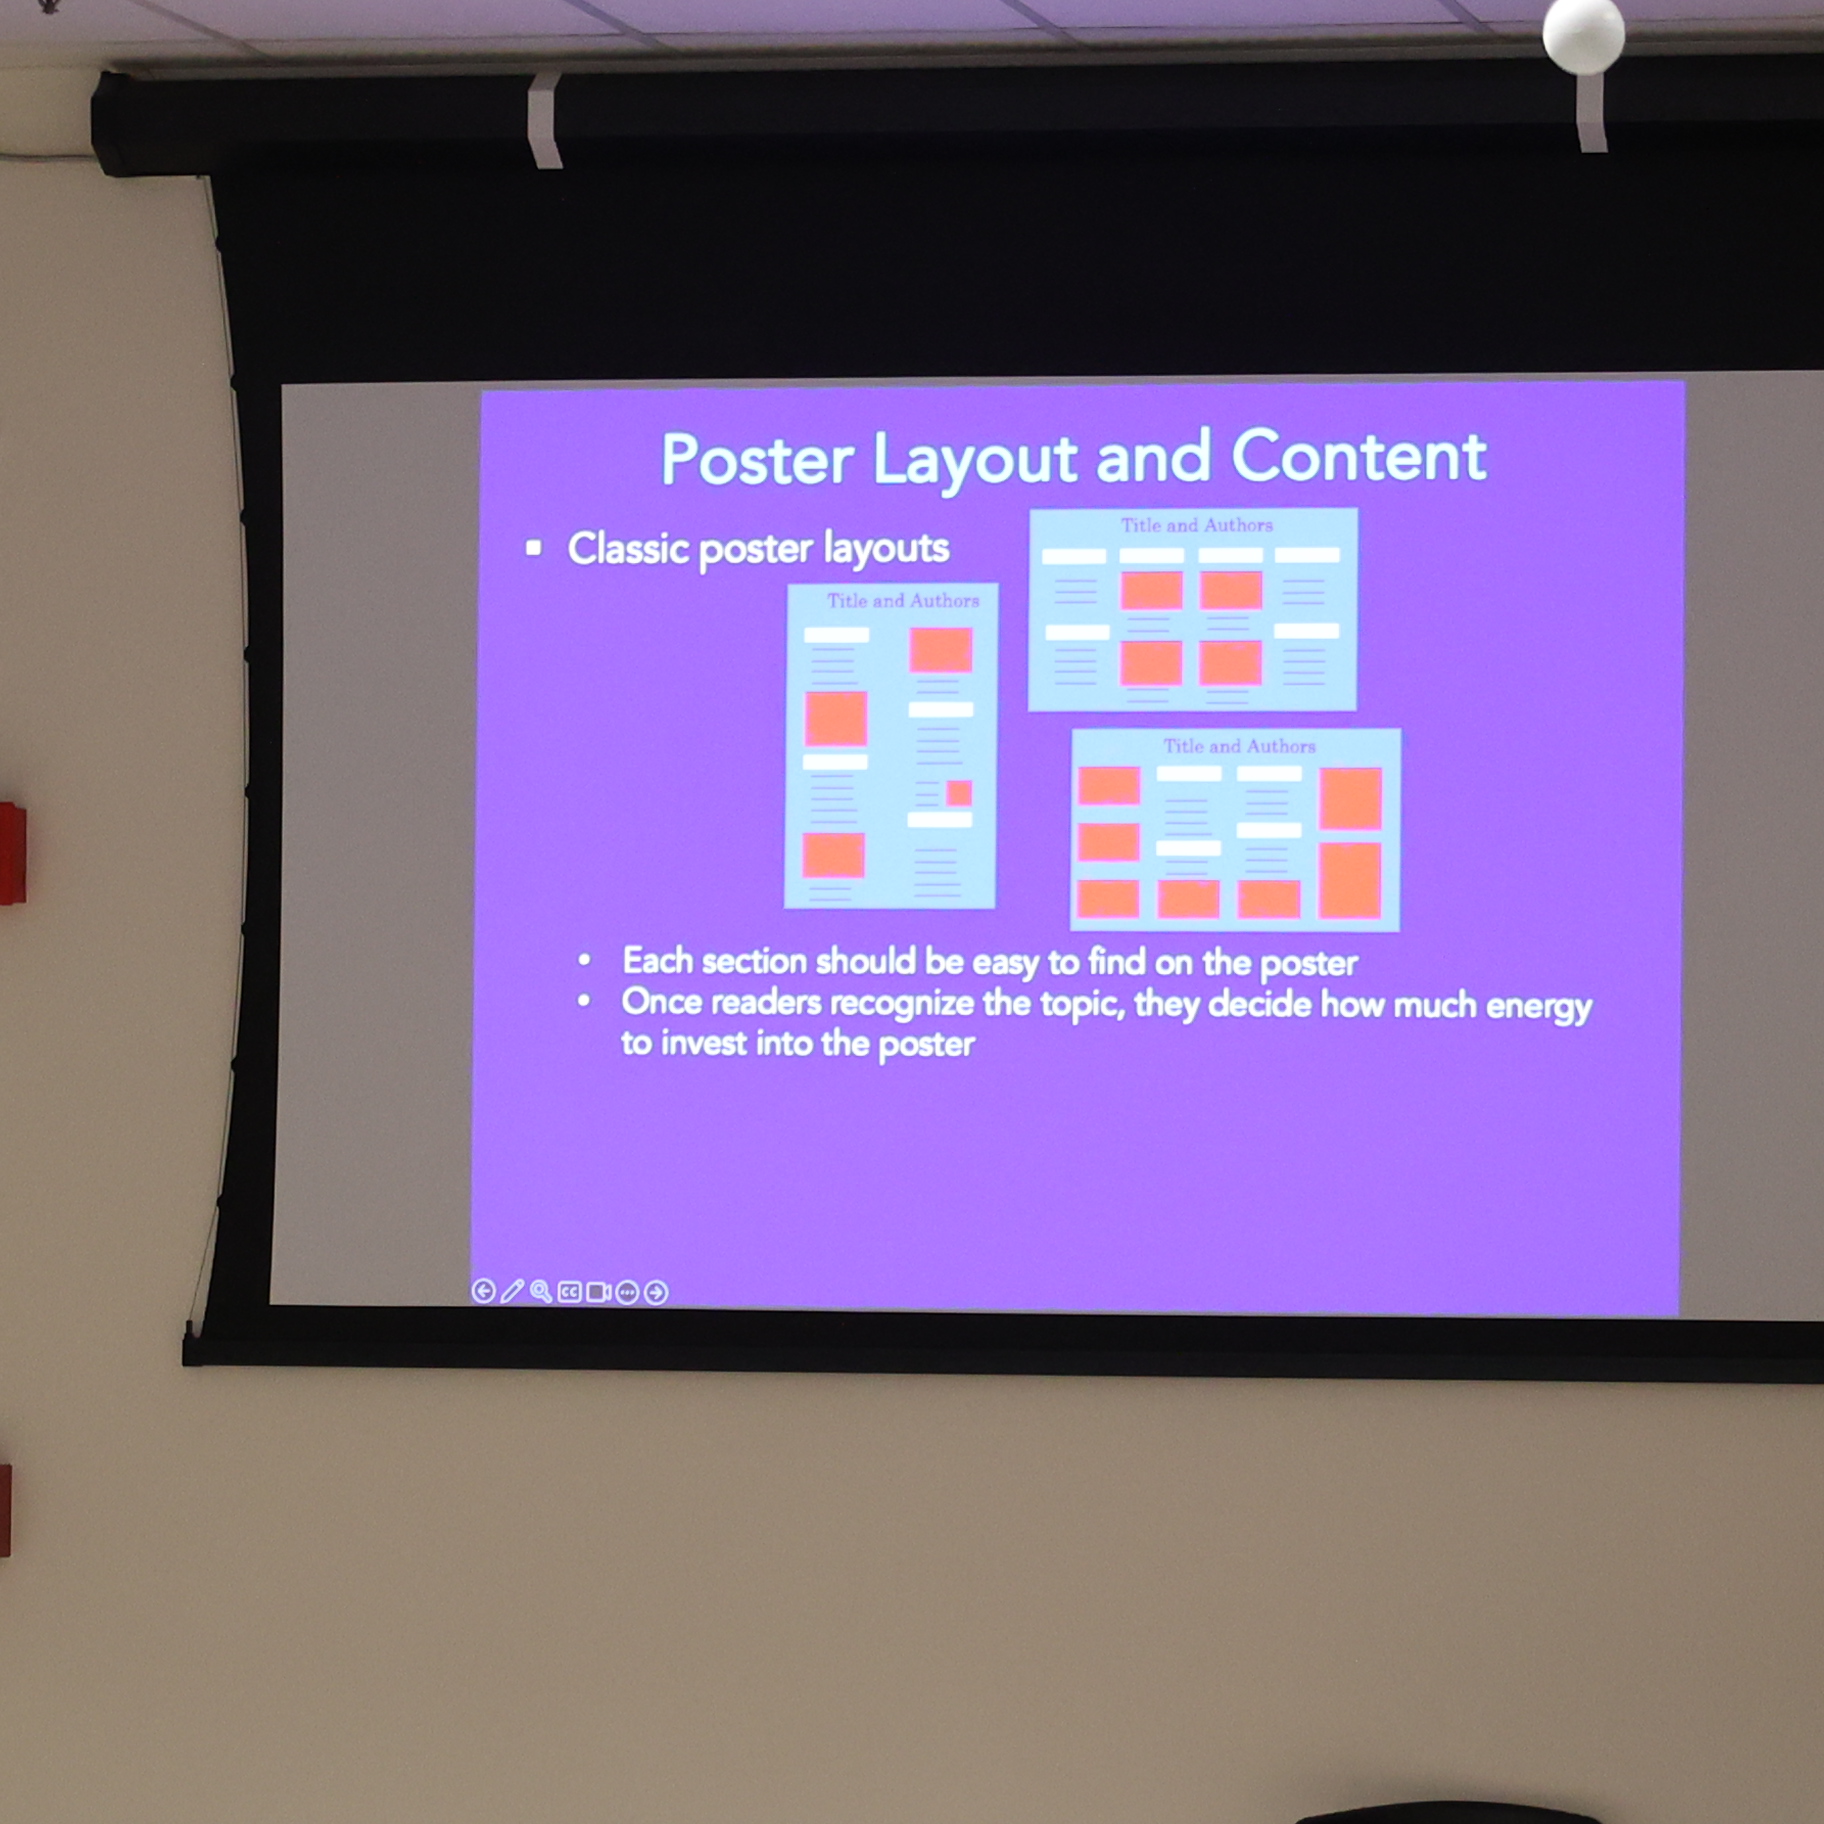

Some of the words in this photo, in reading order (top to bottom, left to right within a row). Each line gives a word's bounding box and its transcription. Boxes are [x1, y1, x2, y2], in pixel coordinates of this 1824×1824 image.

[663, 432, 856, 486] Poster
[875, 430, 1079, 499] Layout
[1096, 425, 1211, 483] and
[1232, 426, 1488, 482] Content
[1121, 517, 1162, 533] Title
[1166, 517, 1199, 533] and
[1204, 517, 1274, 532] Authors
[568, 529, 690, 565] Classic
[699, 534, 815, 576] poster
[824, 527, 951, 573] layouts
[827, 592, 868, 608] Title
[873, 592, 905, 608] and
[910, 592, 980, 608] Authors
[1164, 738, 1204, 754] Title
[1209, 738, 1241, 754] and
[1247, 738, 1316, 754] Authors
[623, 943, 694, 974] Each
[702, 946, 808, 975] section
[815, 944, 917, 975] should
[925, 944, 965, 975] be
[972, 953, 1041, 983] easy
[1047, 950, 1081, 976] to
[1087, 944, 1147, 976] find
[1155, 954, 1193, 976] on
[1201, 945, 1253, 976] the
[1260, 951, 1360, 986] poster
[621, 984, 704, 1015] Once
[711, 984, 823, 1016] readers
[830, 987, 976, 1025] recognize
[981, 985, 1032, 1016] the
[1039, 988, 1126, 1026] topic,
[1133, 986, 1202, 1025] they
[1208, 986, 1313, 1018] decide
[1321, 987, 1387, 1018] how
[1394, 987, 1478, 1019] much
[1486, 997, 1594, 1027] energy
[620, 1030, 653, 1056] to
[661, 1027, 749, 1056] invest
[756, 1028, 815, 1057] into
[820, 1026, 871, 1057] the
[878, 1031, 977, 1066] poster
